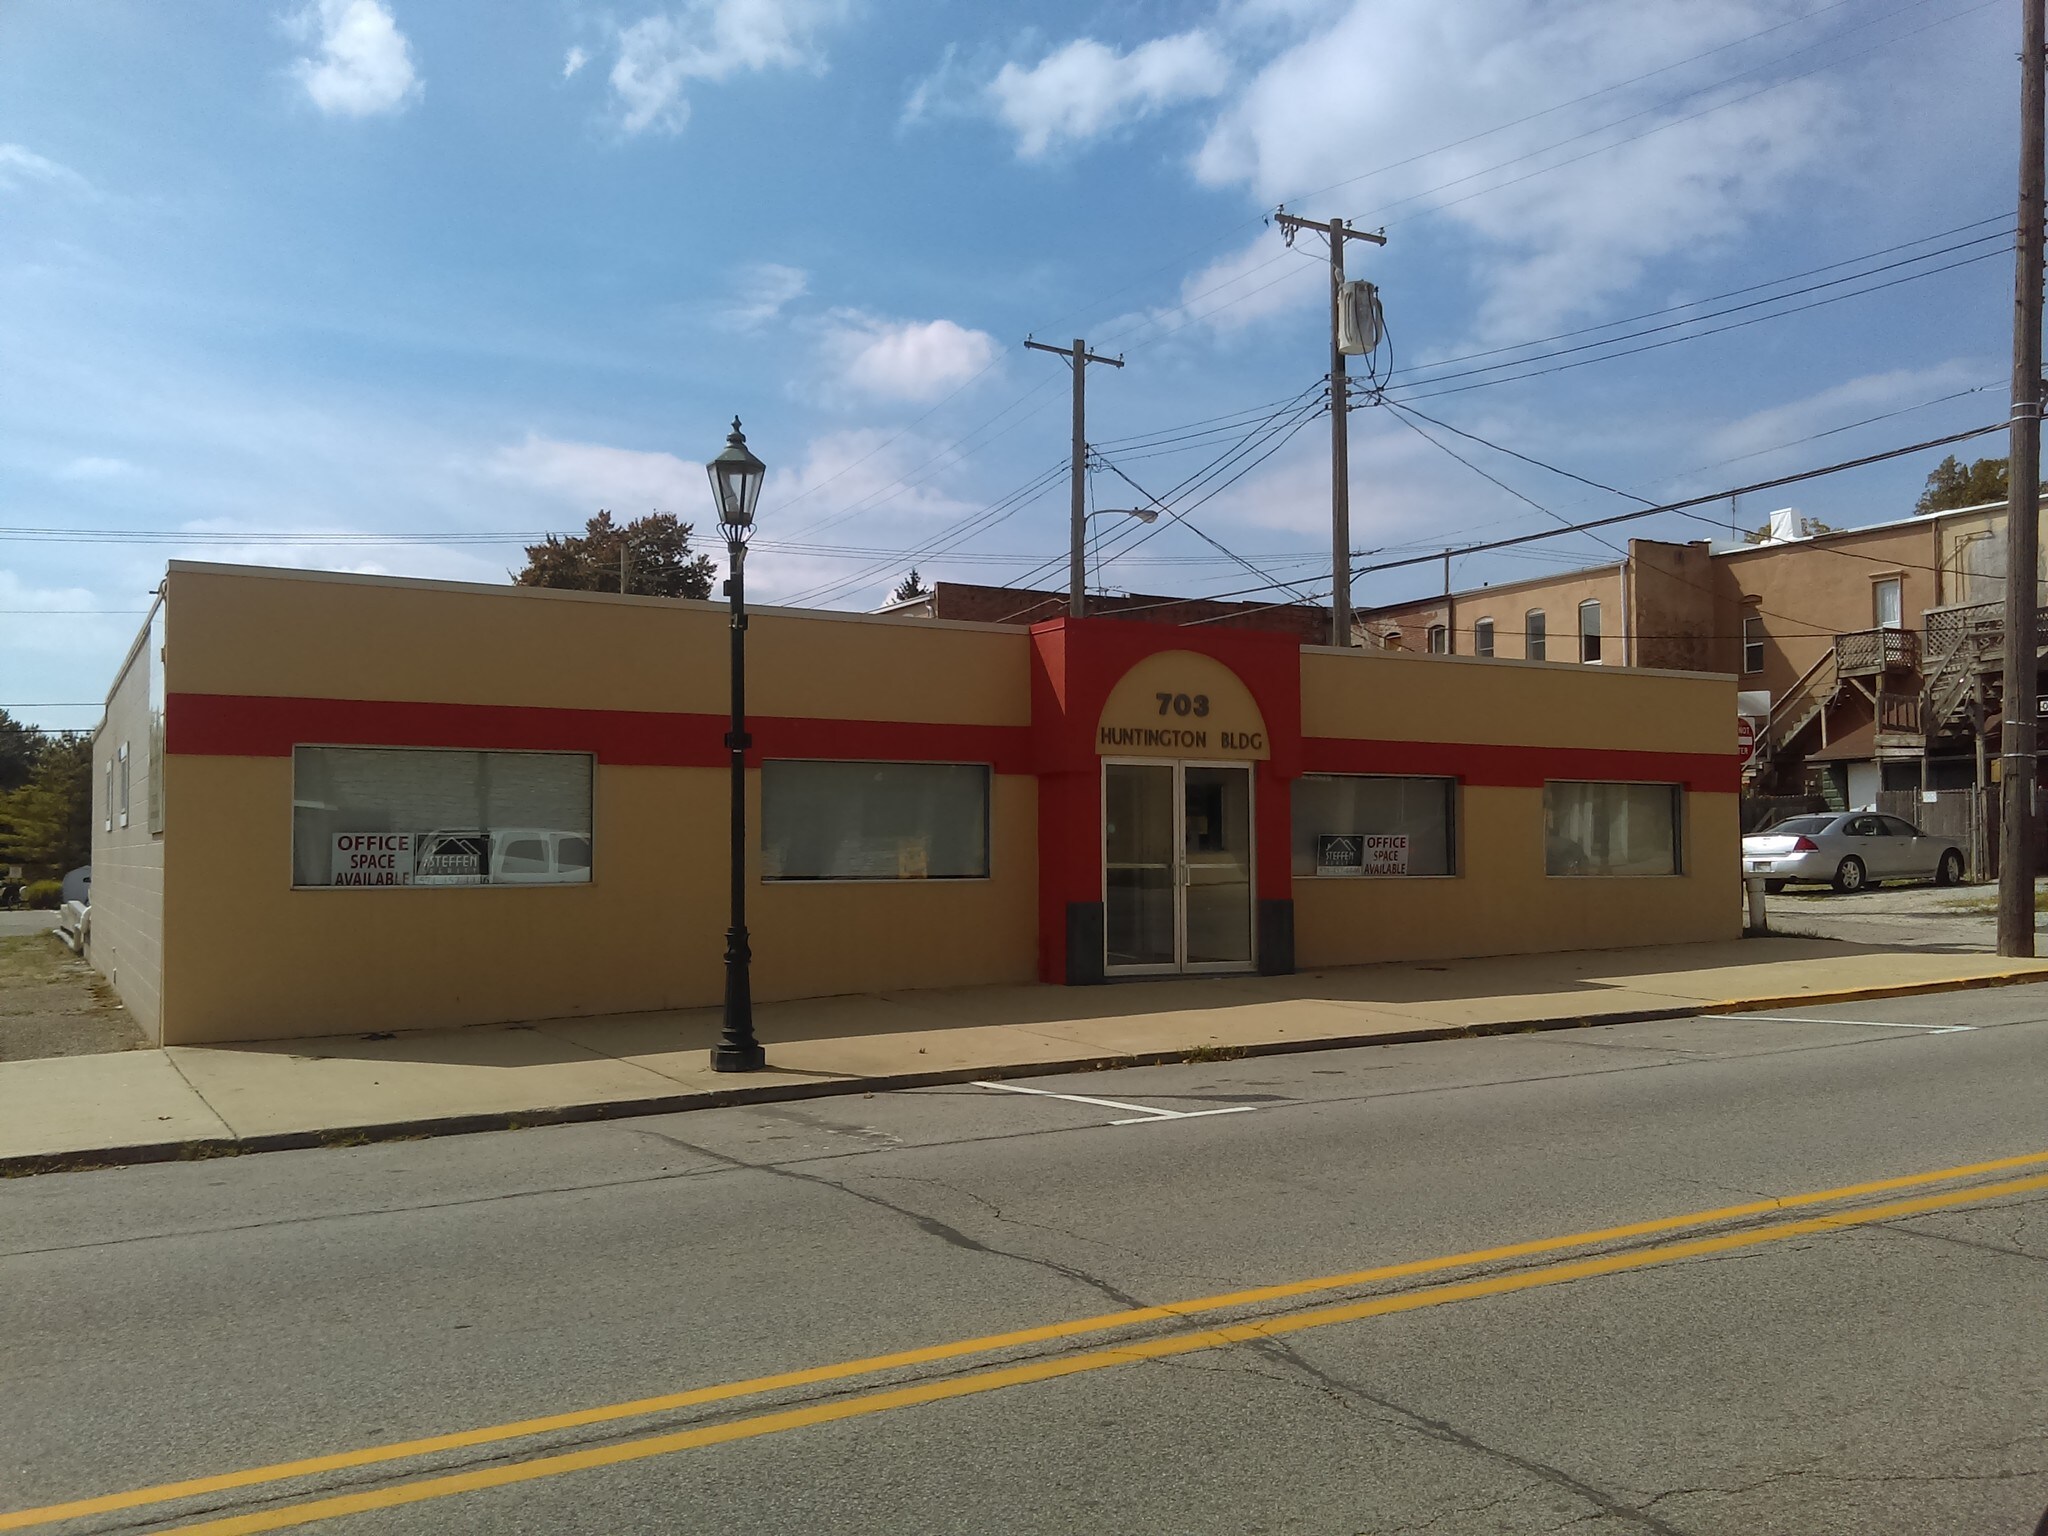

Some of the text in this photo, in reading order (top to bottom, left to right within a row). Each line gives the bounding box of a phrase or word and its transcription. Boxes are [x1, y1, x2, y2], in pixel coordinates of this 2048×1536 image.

[1156, 692, 1210, 717] 703
[1100, 727, 1262, 750] HUNTINGTON BLDG
[337, 835, 409, 851] OFFICE
[1367, 837, 1407, 849] OFFICE
[350, 854, 396, 869] SPACE
[429, 855, 477, 867] STEFFEN
[1325, 851, 1354, 860] STEFFEN
[1373, 850, 1398, 861] SPACE
[1364, 863, 1406, 875] AVAILABLE
[335, 872, 410, 886] AVAILABLE
